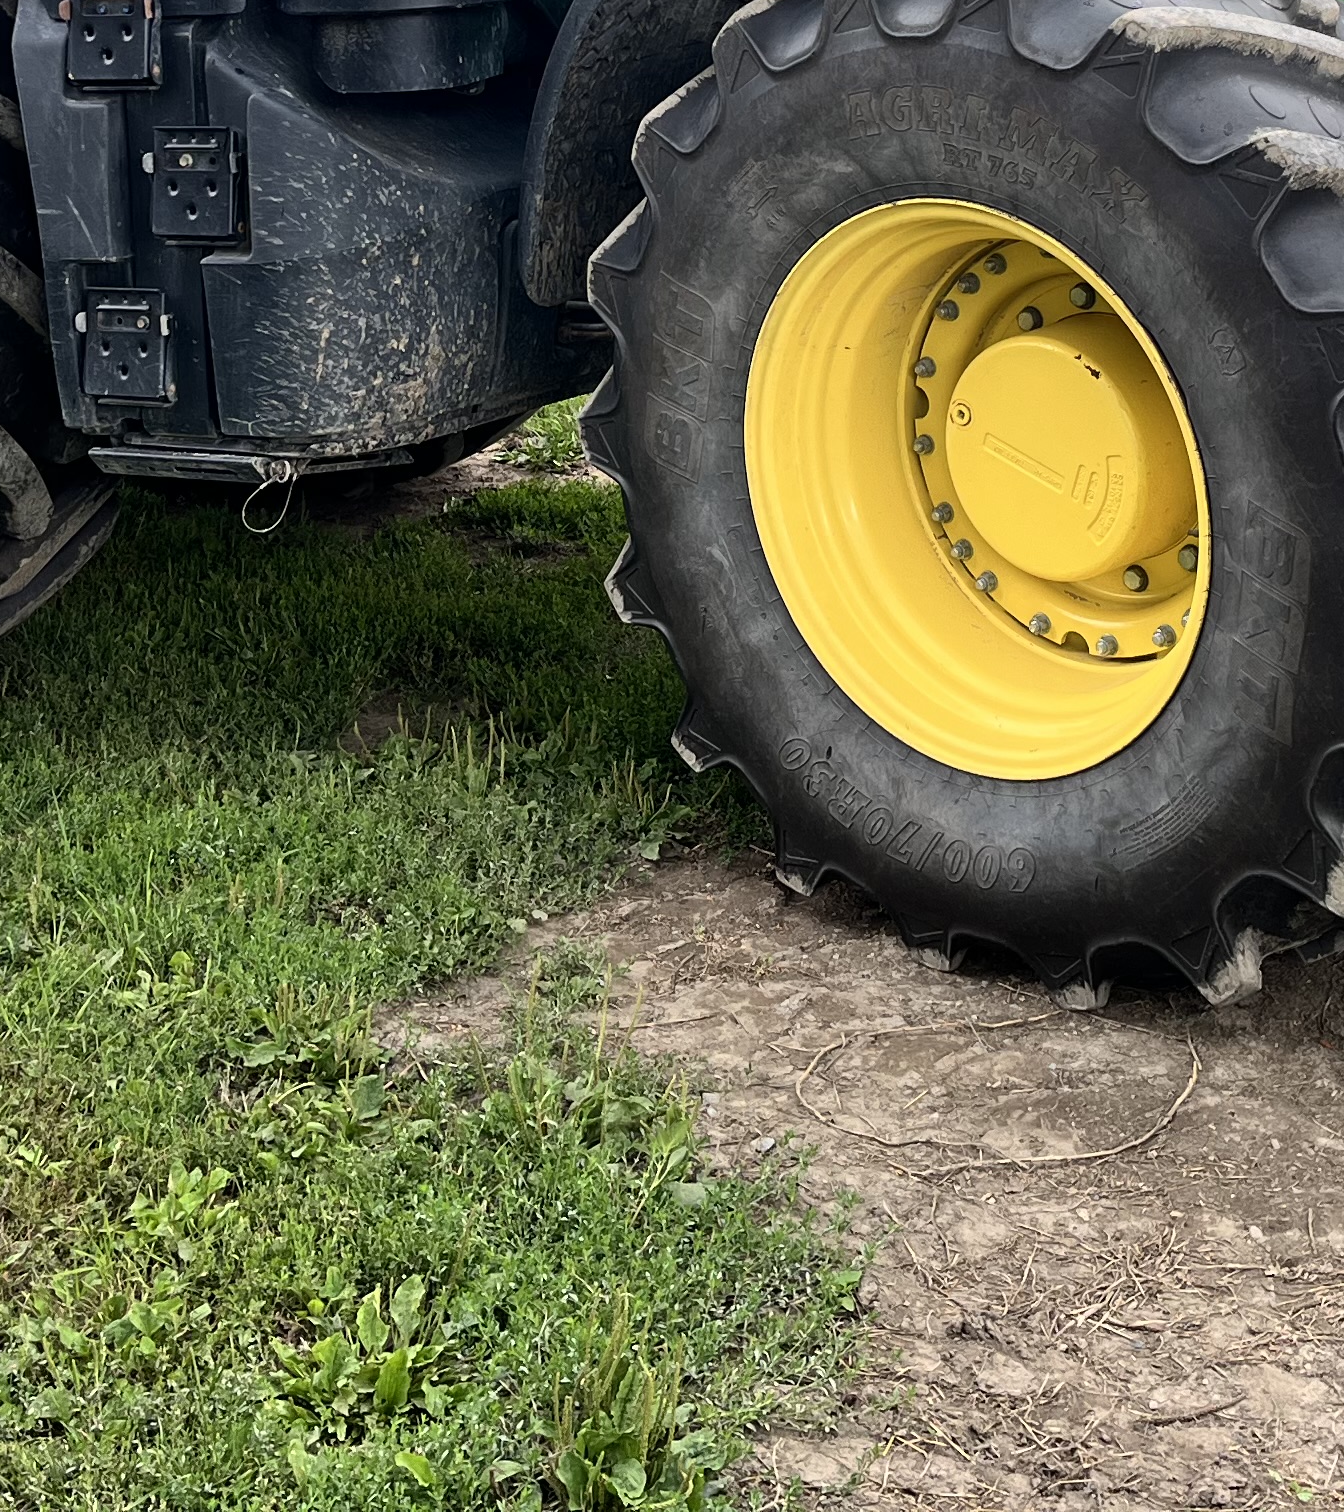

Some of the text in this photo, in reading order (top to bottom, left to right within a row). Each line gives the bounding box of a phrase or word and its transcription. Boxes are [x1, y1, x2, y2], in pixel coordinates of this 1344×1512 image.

[942, 142, 1038, 189] RT 765
[653, 283, 706, 473] BKT
[1237, 508, 1299, 733] BKT
[778, 737, 1037, 893] 600/70R30
